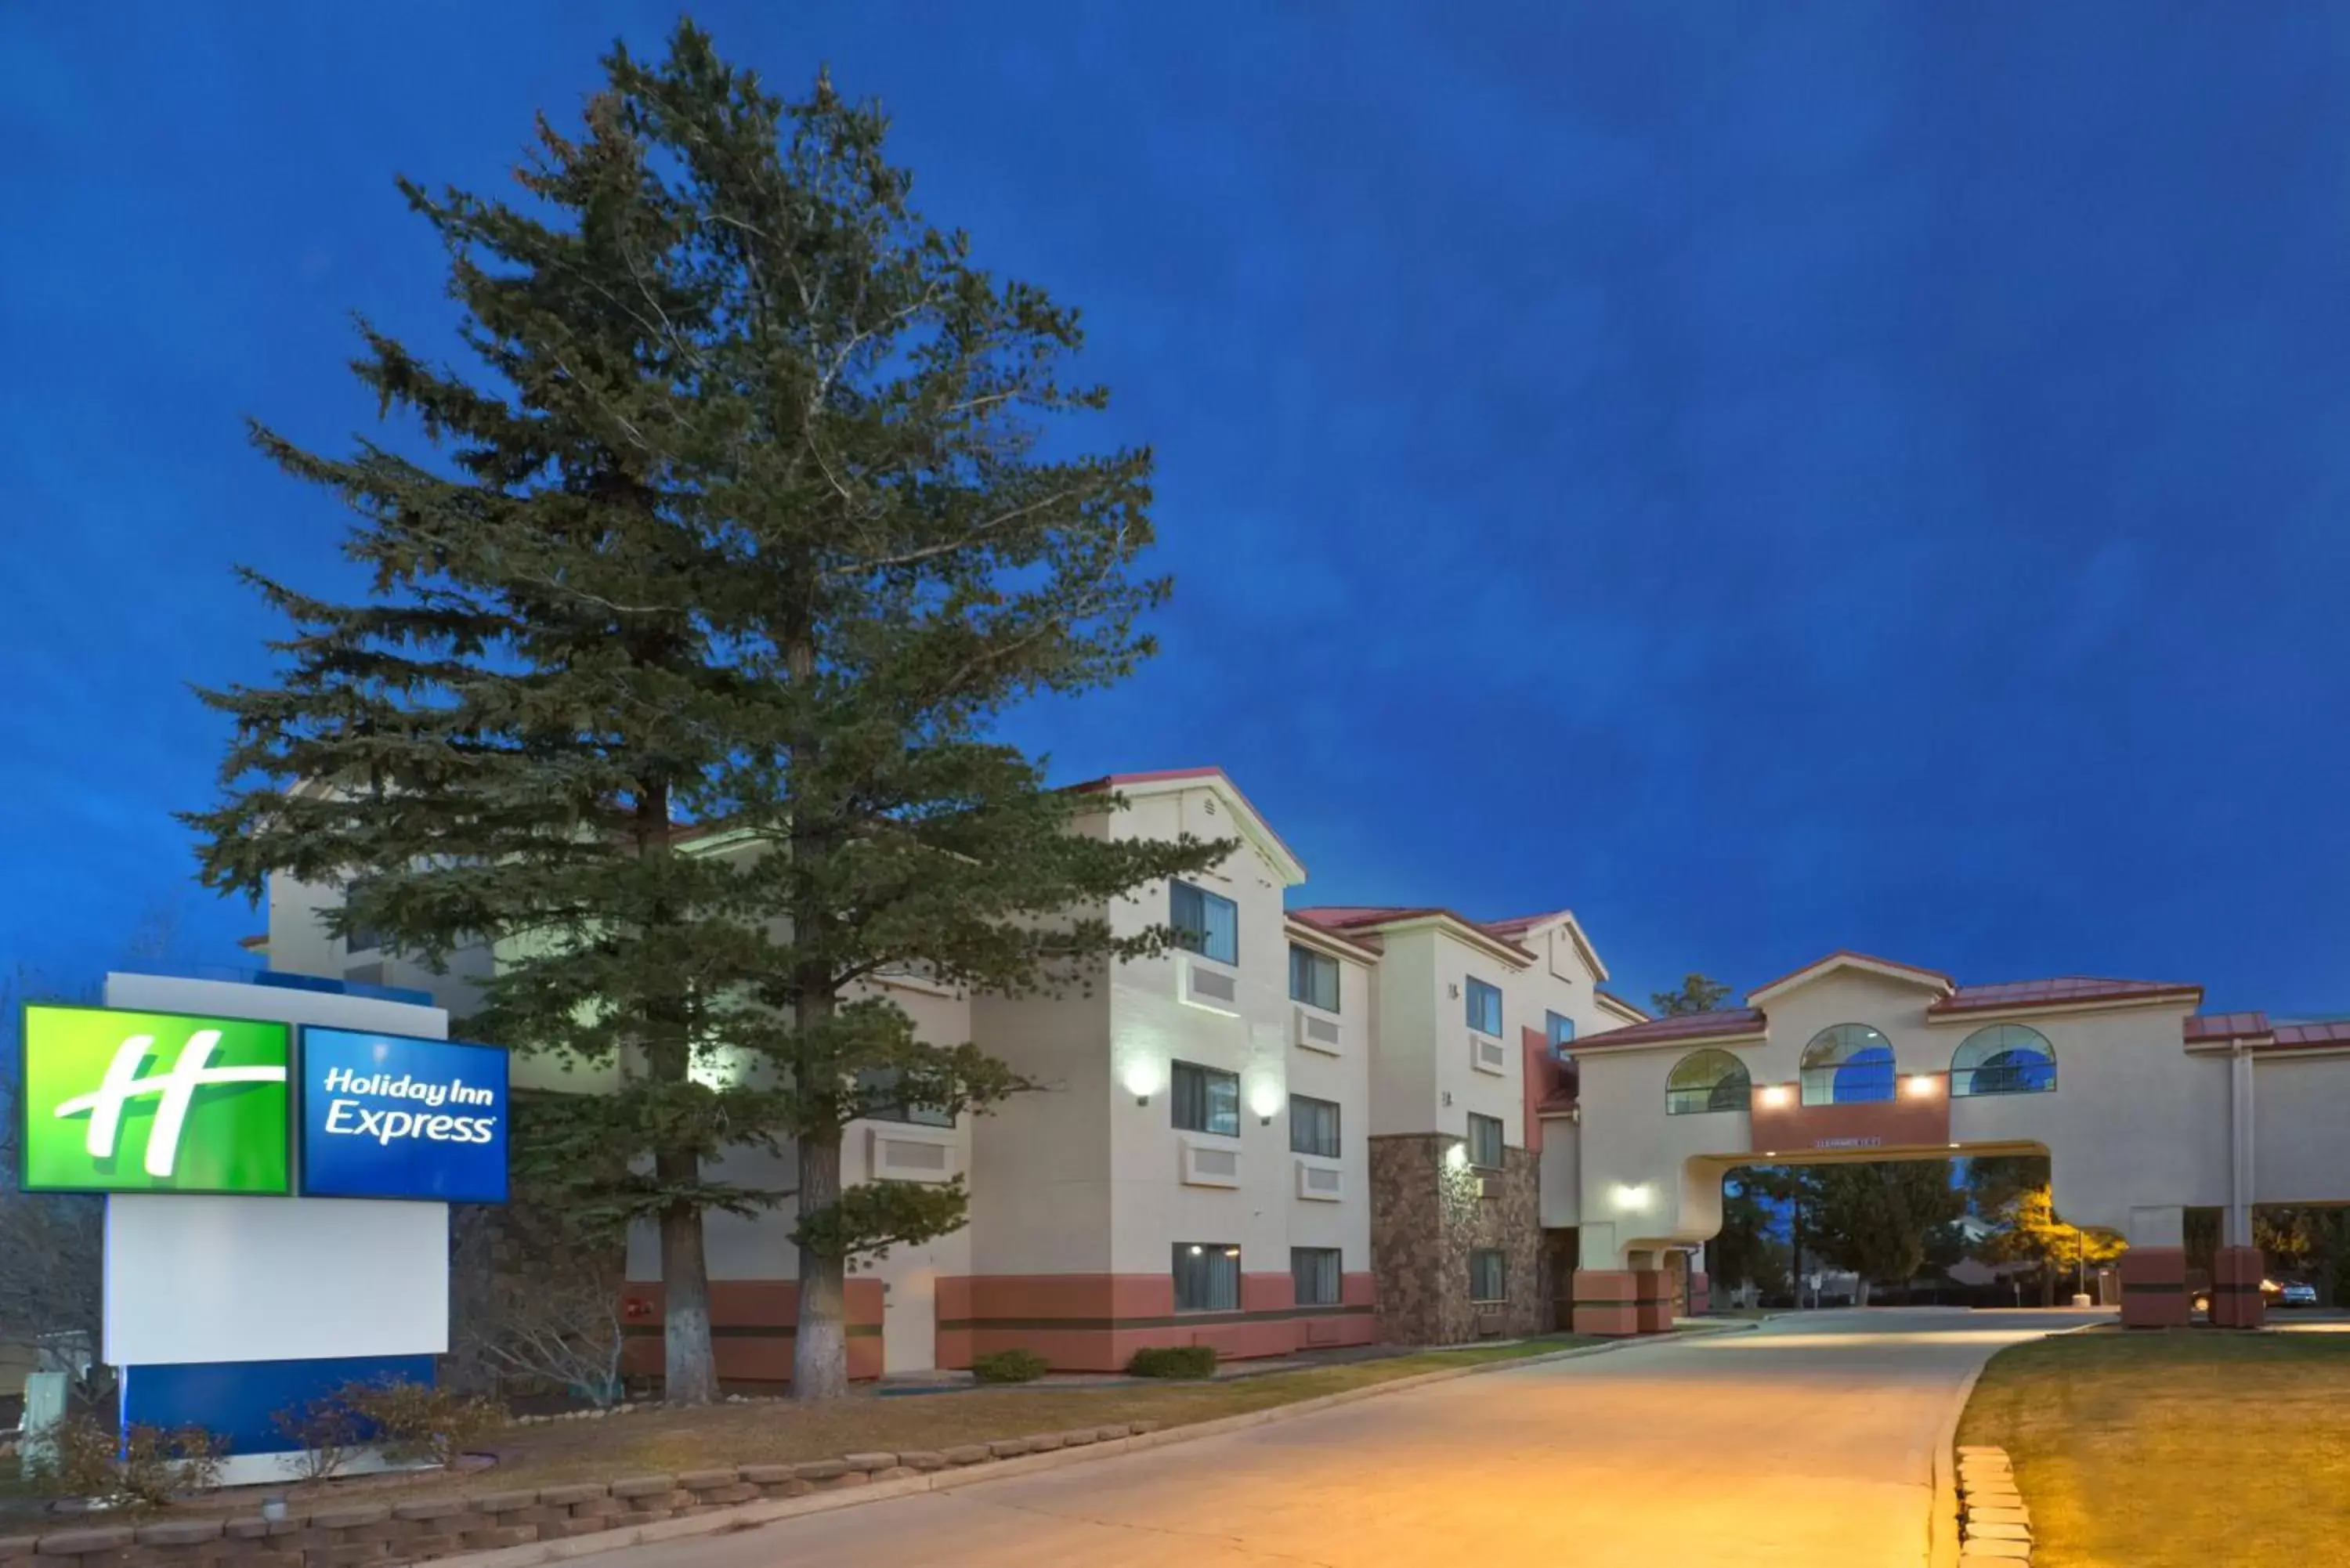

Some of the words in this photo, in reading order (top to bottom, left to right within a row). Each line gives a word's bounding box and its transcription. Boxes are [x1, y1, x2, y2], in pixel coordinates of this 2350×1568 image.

[324, 1067, 447, 1107] Holiday
[449, 1078, 494, 1106] Inn
[325, 1099, 496, 1146] Express
